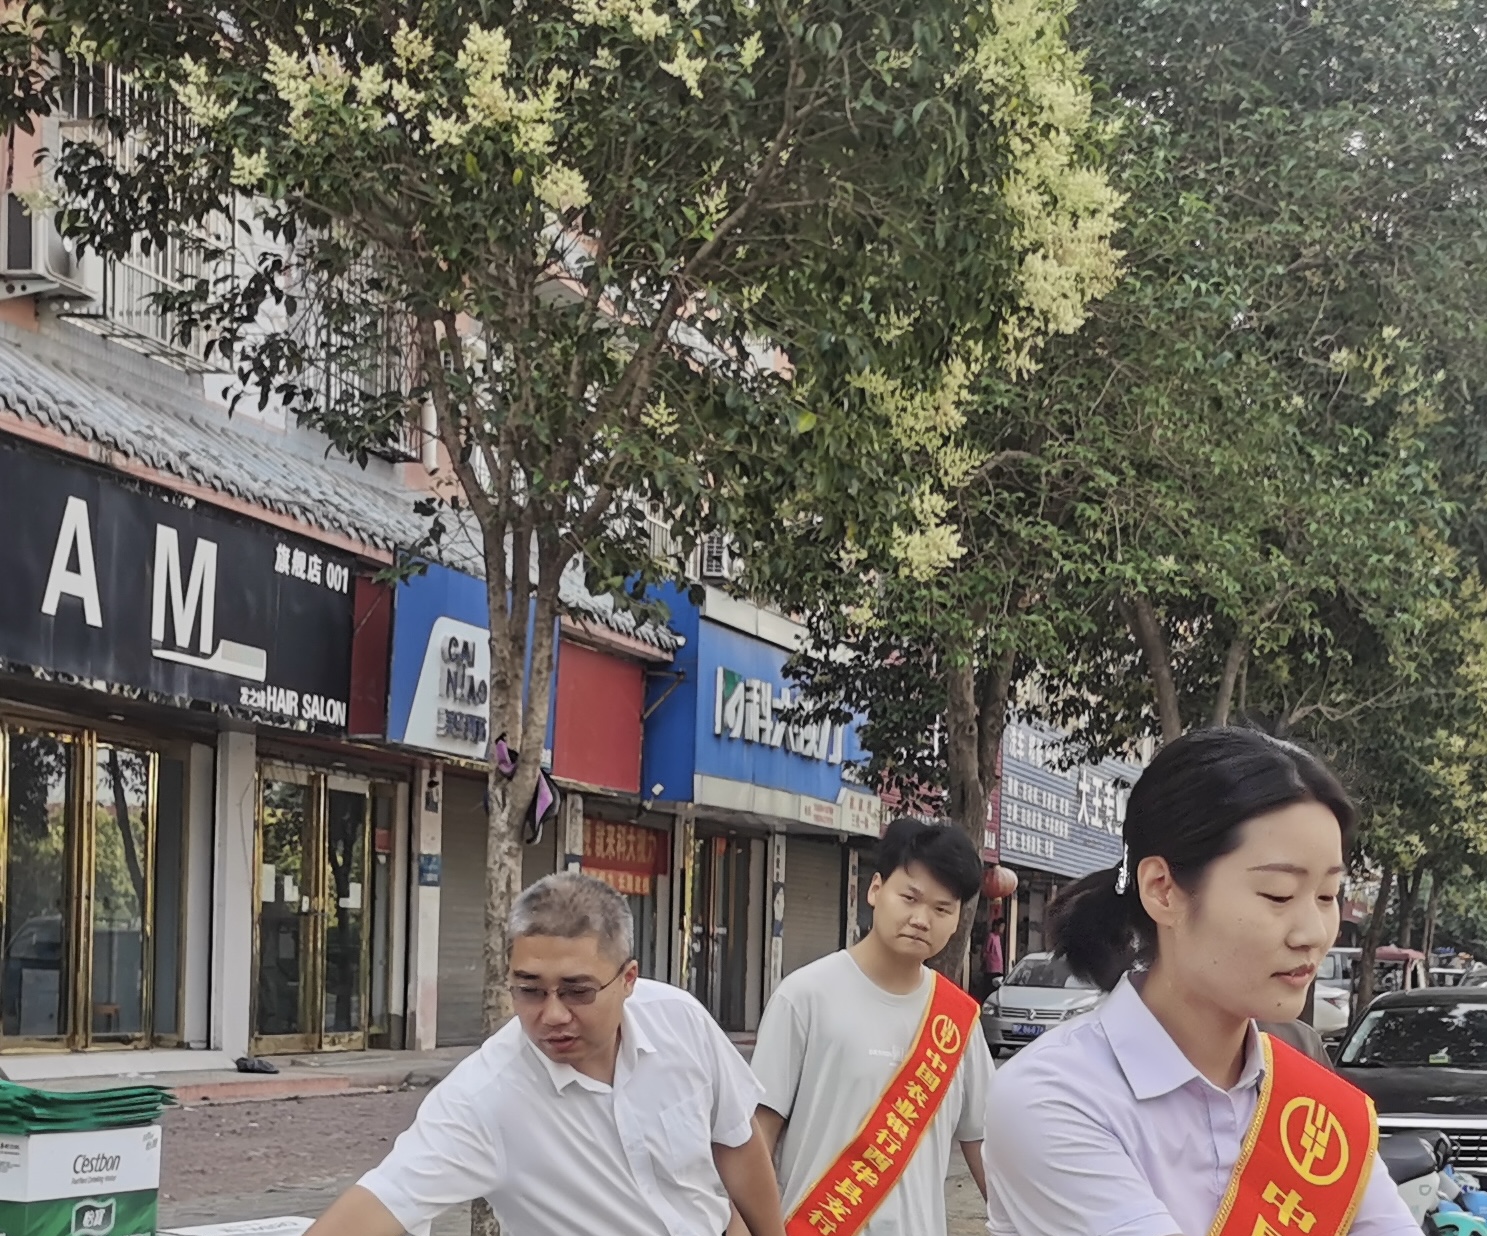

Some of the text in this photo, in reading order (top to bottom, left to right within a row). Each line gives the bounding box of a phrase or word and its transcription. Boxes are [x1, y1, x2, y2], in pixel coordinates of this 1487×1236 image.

[274, 542, 349, 594] 旗舰店 001
[266, 684, 299, 717] HAIR
[301, 693, 347, 727] SALON
